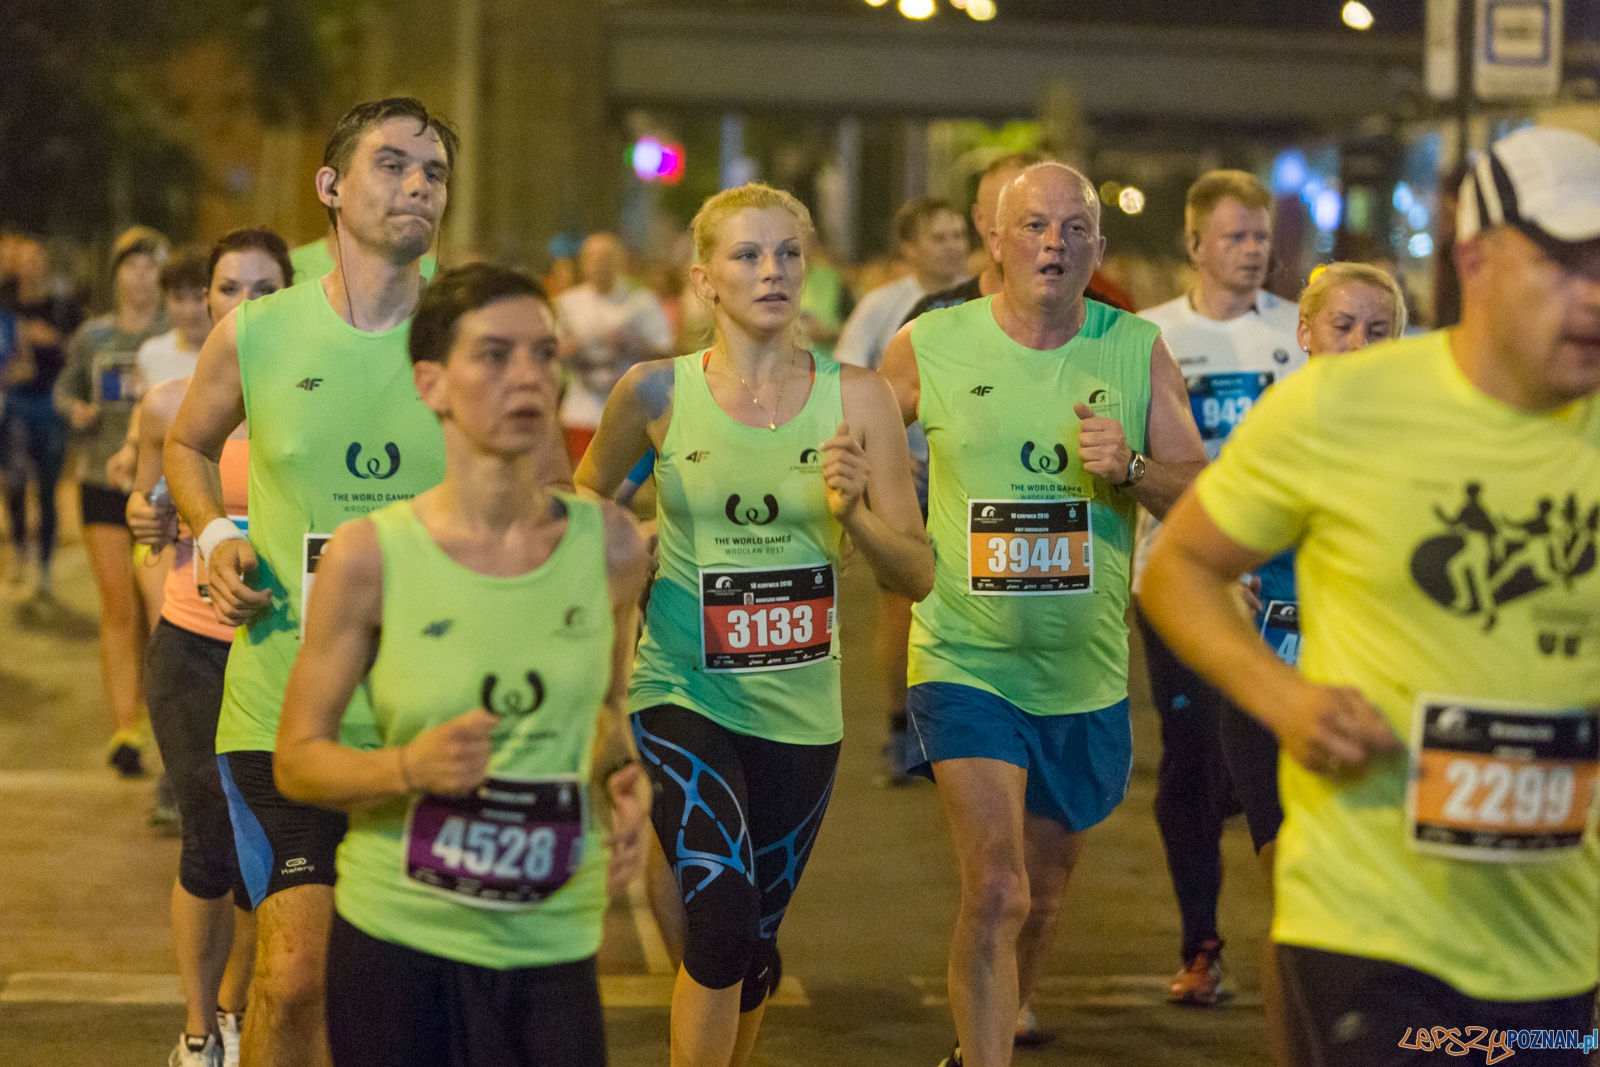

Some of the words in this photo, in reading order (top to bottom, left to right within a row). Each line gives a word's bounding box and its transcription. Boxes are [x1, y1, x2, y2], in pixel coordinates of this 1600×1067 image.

[970, 385, 994, 397] 4F
[332, 493, 349, 502] THE
[351, 493, 384, 502] WORLD
[1011, 483, 1025, 491] THE
[1027, 484, 1056, 492] WORLD
[715, 537, 730, 545] THE
[732, 536, 763, 545] WORLD
[765, 535, 792, 544] GAMES
[987, 536, 1072, 573] 3944
[727, 604, 813, 649] 3133
[1443, 759, 1575, 827] 2299
[431, 817, 557, 880] 4528
